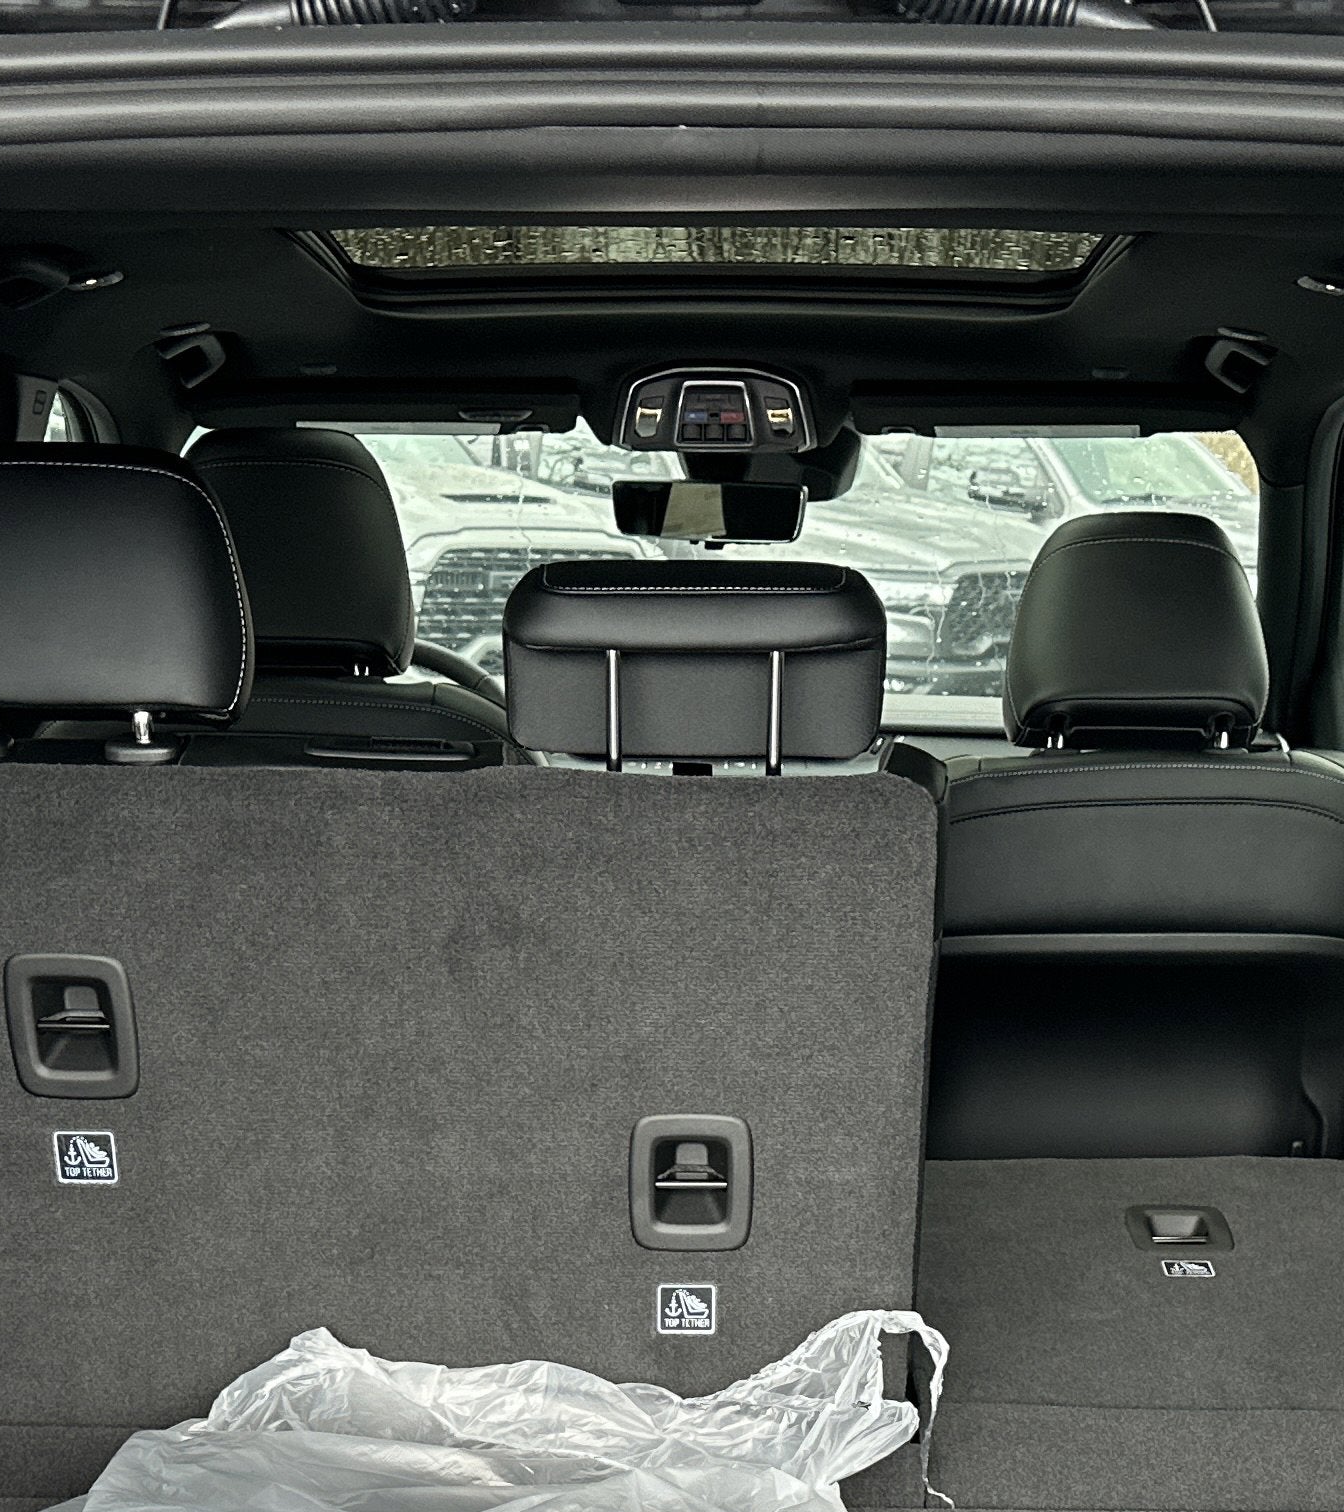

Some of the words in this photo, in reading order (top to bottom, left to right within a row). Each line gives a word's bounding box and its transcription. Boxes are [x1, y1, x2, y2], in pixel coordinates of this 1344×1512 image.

[64, 1167, 80, 1176] TOP
[82, 1168, 112, 1177] TETHER
[664, 1318, 679, 1327] TOP
[681, 1318, 709, 1327] TETHER
